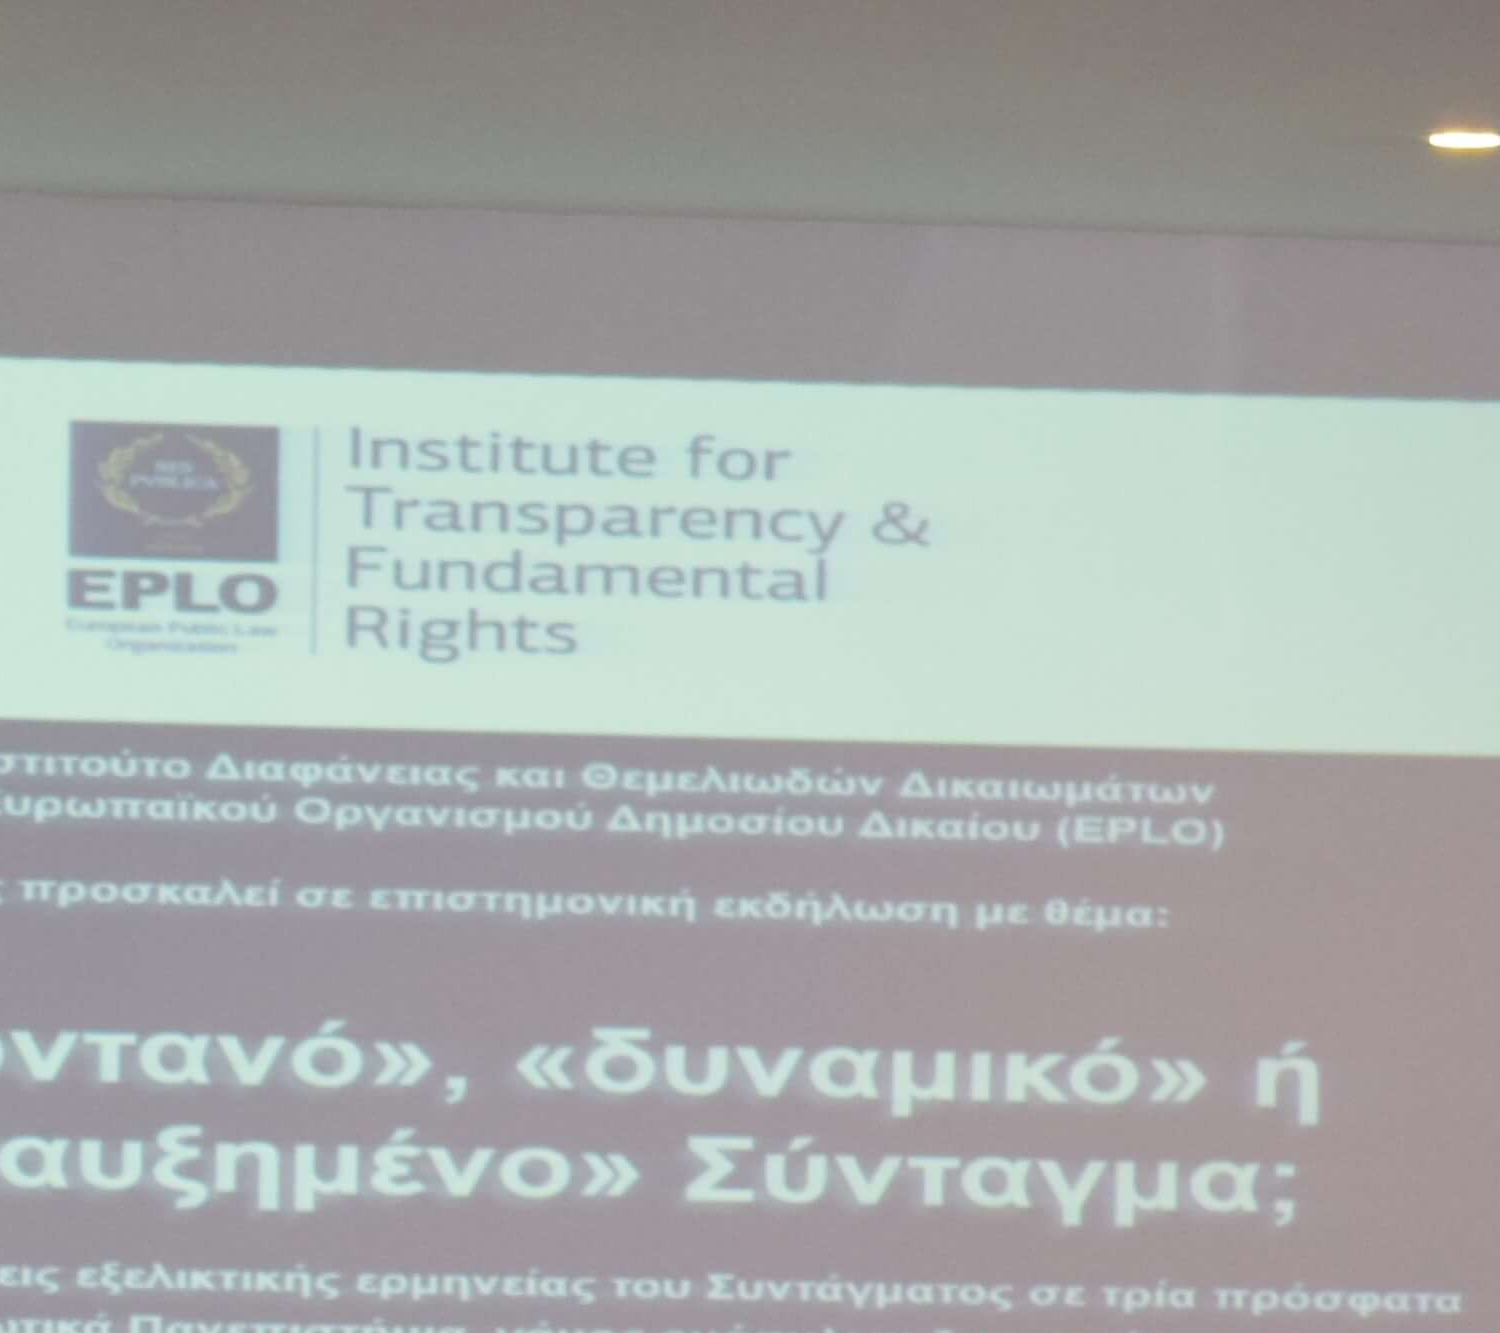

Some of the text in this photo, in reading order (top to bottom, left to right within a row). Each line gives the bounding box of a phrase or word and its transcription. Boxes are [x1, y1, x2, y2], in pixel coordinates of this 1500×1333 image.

[349, 425, 793, 482] Institute for
[344, 485, 930, 555] Transparency &
[66, 568, 280, 615] EPLO
[345, 546, 831, 602] Fundamental
[345, 604, 579, 665] Rights
[204, 752, 480, 794] Διαφάνειας
[495, 767, 565, 789] και
[579, 762, 885, 799] Θεμελιωδών
[897, 770, 1215, 809] Δικαιωμάτων
[293, 796, 594, 836] Οργανισμού
[605, 803, 845, 840] Δημοσίου
[857, 810, 1042, 842] Δικαίου
[1055, 815, 1225, 851] (EPLO)
[20, 879, 280, 909] προσκαλεί
[294, 887, 353, 910] σε
[368, 888, 697, 924] επιστημονική
[712, 891, 960, 930] εκδήλωση
[974, 903, 1029, 931] με
[1043, 898, 1169, 933] θέμα:
[515, 1026, 1208, 1118] «δυναμικό»
[1254, 1040, 1320, 1127] ή
[683, 1134, 1296, 1229] Σύνταγμα;
[75, 1261, 341, 1300] εξελικτικής
[355, 1268, 596, 1305] ερμηνείας
[613, 1277, 692, 1300] του
[704, 1272, 1014, 1312] Συντάγματος
[1028, 1285, 1085, 1307] σε
[1102, 1280, 1196, 1314] τρία
[1214, 1282, 1462, 1319] πρόσφατα
